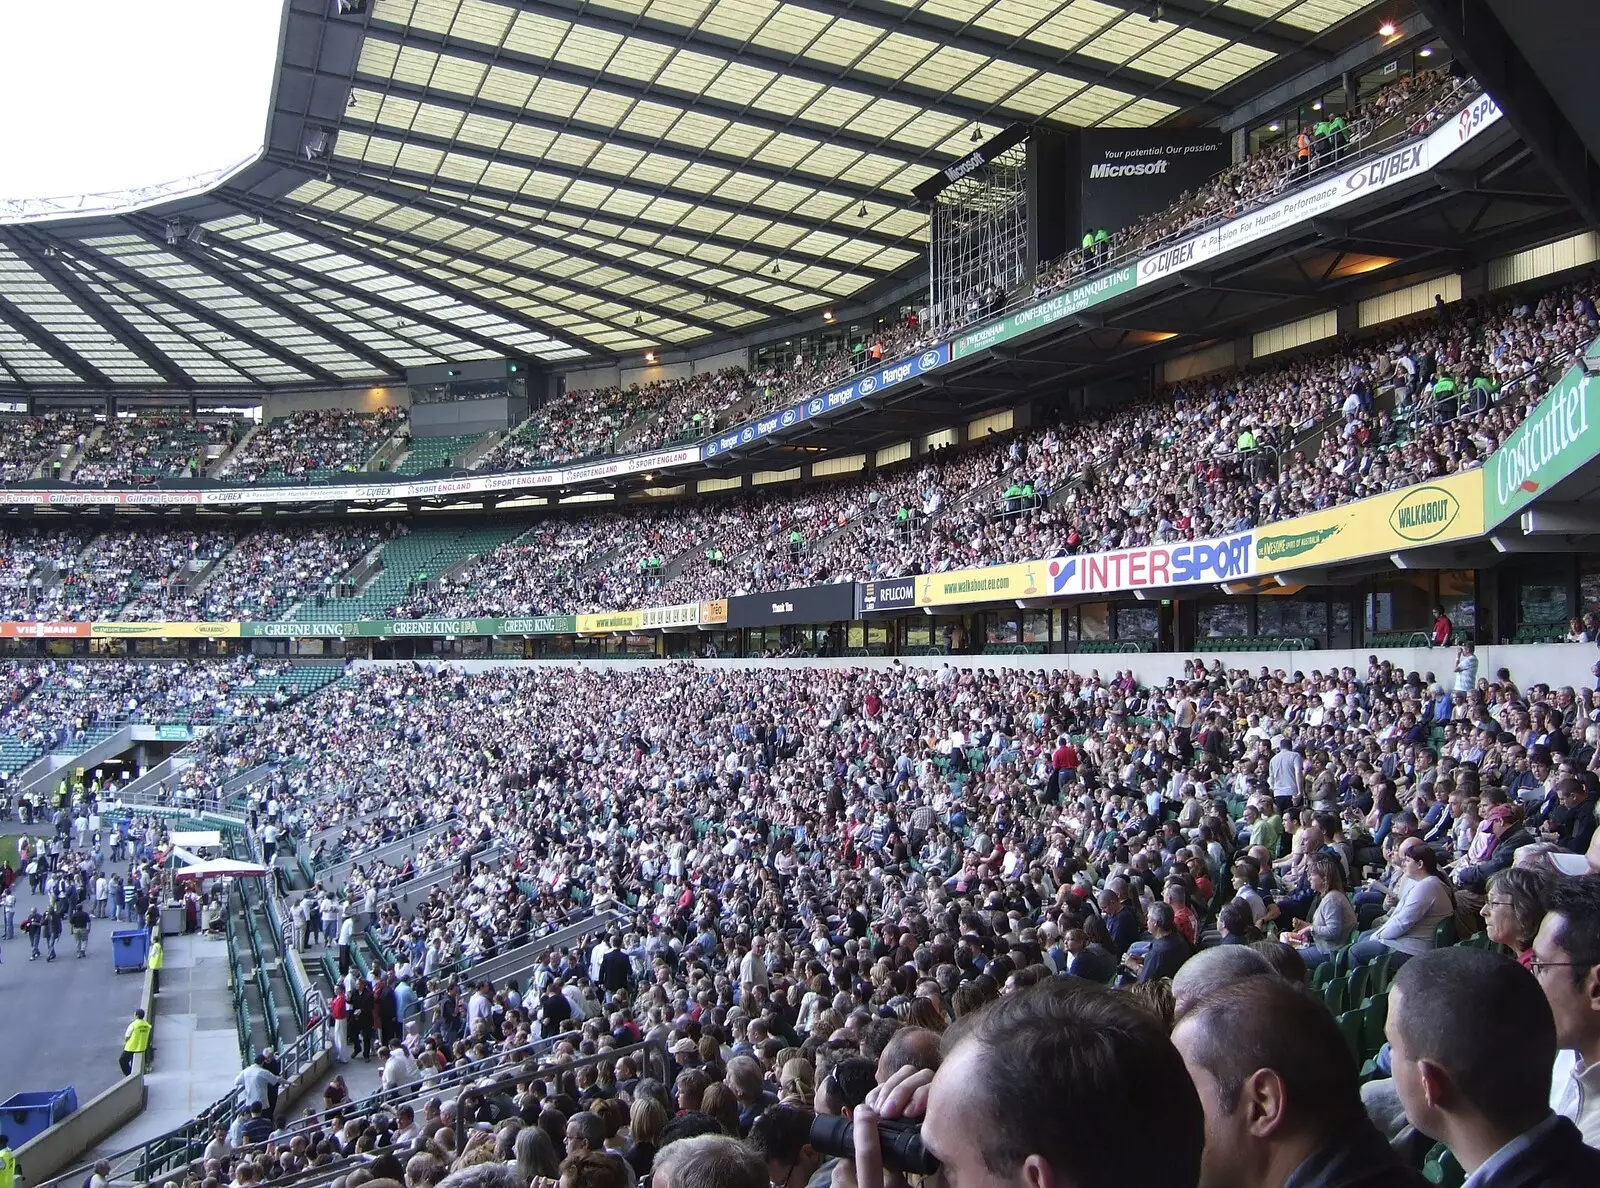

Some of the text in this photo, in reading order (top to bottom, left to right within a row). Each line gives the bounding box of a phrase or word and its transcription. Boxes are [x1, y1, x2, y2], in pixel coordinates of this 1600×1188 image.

[1104, 150, 1123, 160] Your
[1125, 146, 1164, 160] potential.
[1166, 145, 1182, 155] Our
[944, 152, 986, 182] Microsoft
[1090, 160, 1168, 179] Microsoft
[1368, 144, 1423, 186] CYBEX
[1158, 241, 1195, 272] CYBEX
[1202, 240, 1207, 250] A
[1210, 228, 1237, 245] Passion
[1240, 221, 1252, 234] For
[1255, 209, 1280, 227] Human
[1284, 187, 1338, 215] Performance
[1015, 269, 1129, 326] CONFERENCE & BANQUETING
[966, 323, 1004, 346] TWICKENHAM
[828, 388, 853, 406] Ranger
[882, 363, 912, 384] Ranger
[720, 433, 738, 449] Ranger
[757, 418, 778, 435] Ranger
[1498, 377, 1590, 505] Costcutter
[636, 453, 687, 469] SPORT ENGLAND
[493, 476, 552, 487] SPORT ENGLAND
[573, 465, 617, 479] SPORT ENGLAND
[438, 483, 471, 492] ENGLAND
[1398, 499, 1448, 529] WALKABOUT
[1264, 539, 1286, 556] AWESOME
[1082, 535, 1252, 590] INTERSPORT
[944, 577, 1010, 594] www.walkabout.eu.com
[265, 623, 312, 635] GREENE
[313, 623, 344, 635] KING
[344, 623, 359, 635] IPA
[393, 621, 478, 635] GREENE KING IPA
[504, 619, 534, 633] GREENE
[535, 618, 554, 632] KING
